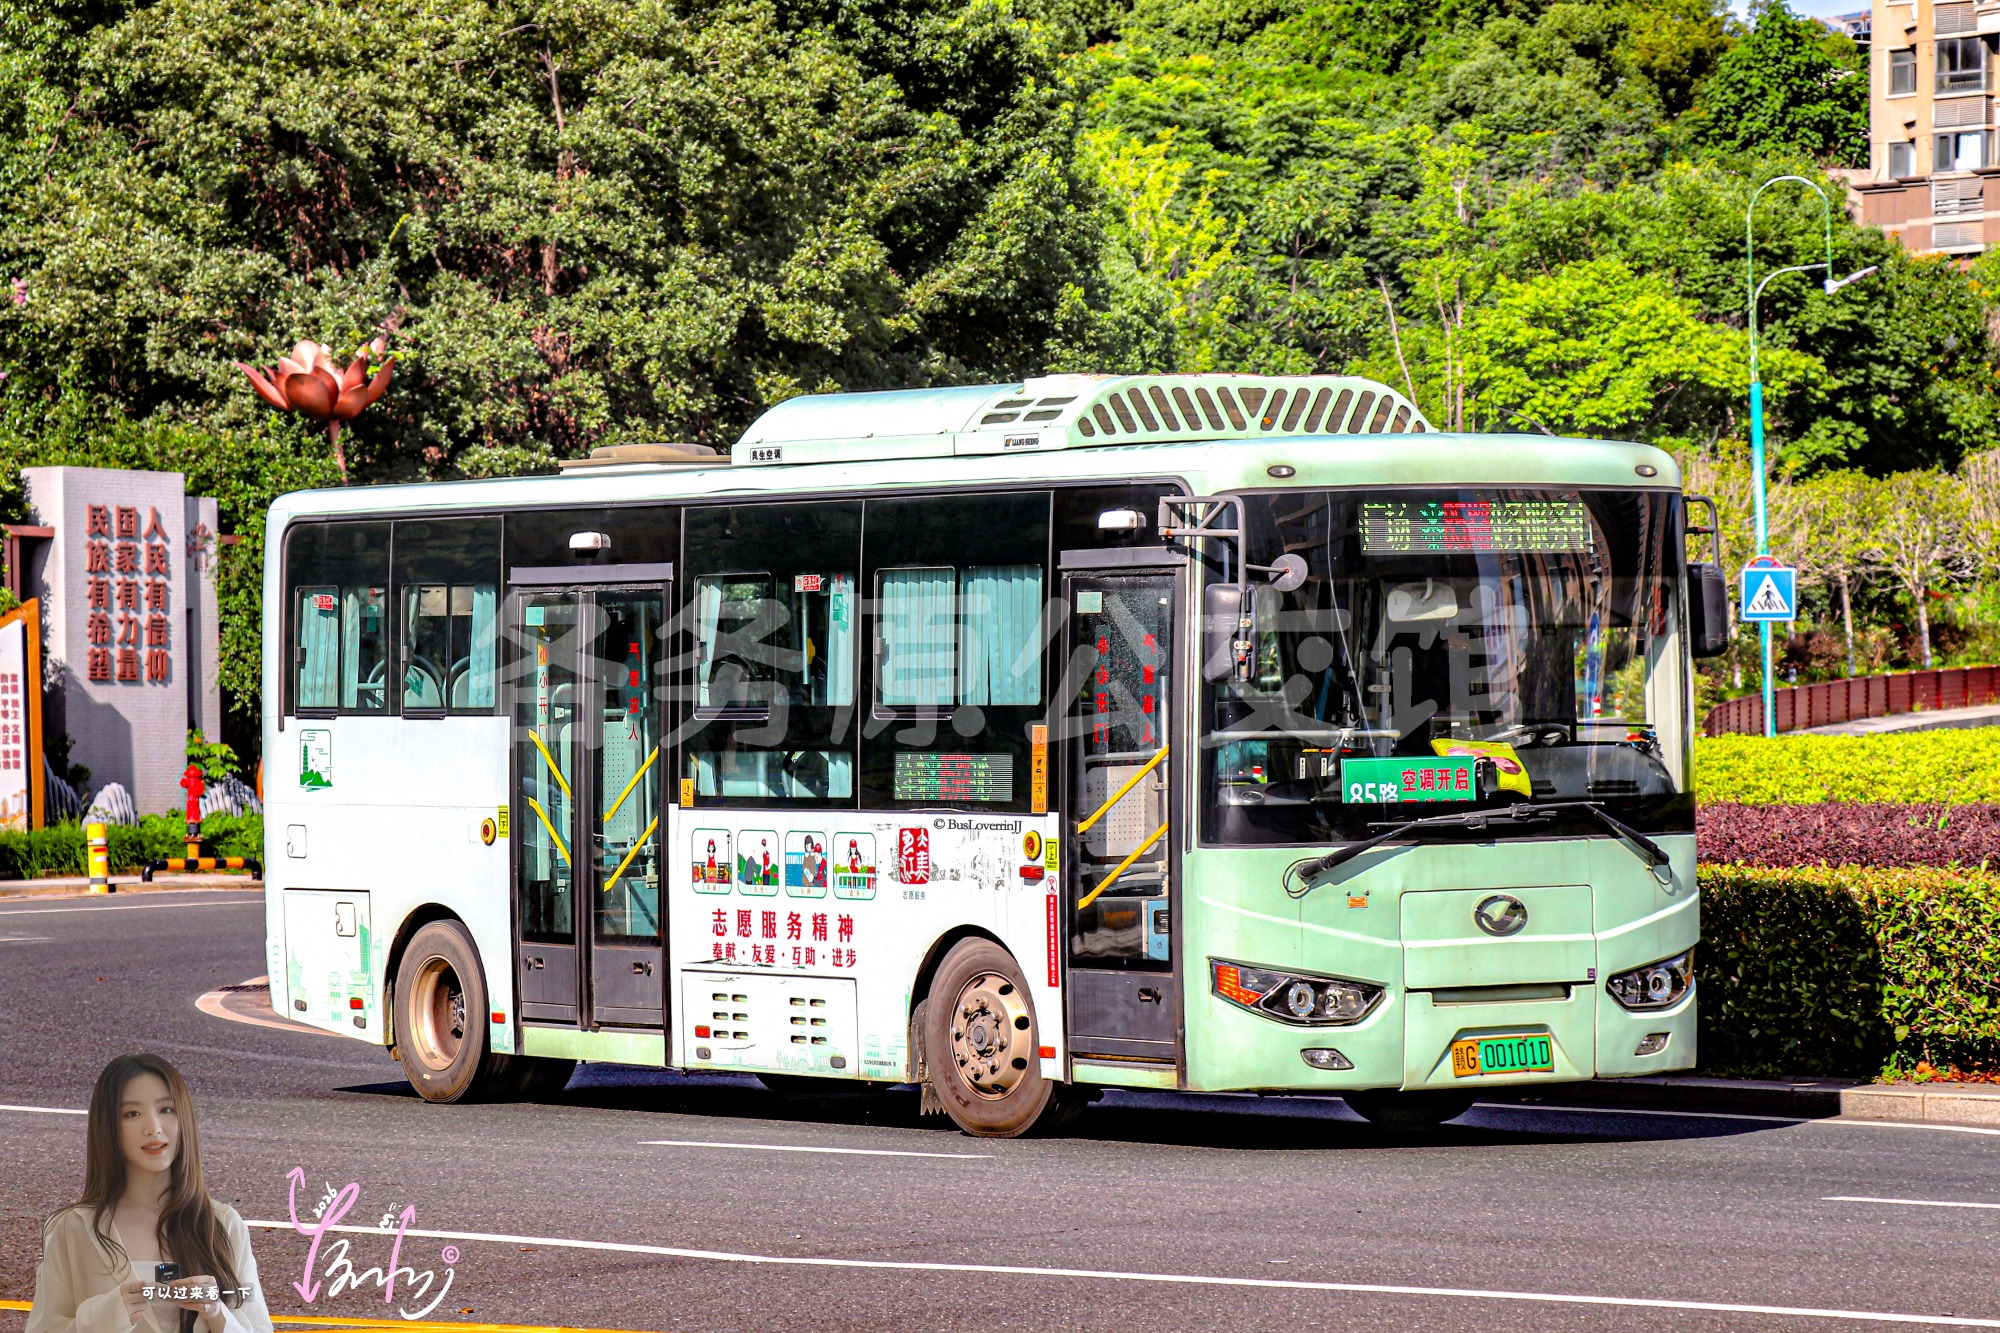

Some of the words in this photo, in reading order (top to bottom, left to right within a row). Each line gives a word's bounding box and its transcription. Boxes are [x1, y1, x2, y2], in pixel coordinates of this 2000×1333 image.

[752, 449, 781, 461] 良生空调
[85, 503, 111, 681] 民族有希望
[114, 505, 140, 681] 国家有力量
[142, 506, 169, 682] 人民有信仰
[1350, 782, 1399, 803] 85路
[1401, 766, 1469, 792] 空调开启
[902, 890, 926, 900] 志愿服务
[711, 908, 854, 943] 志愿服务精神
